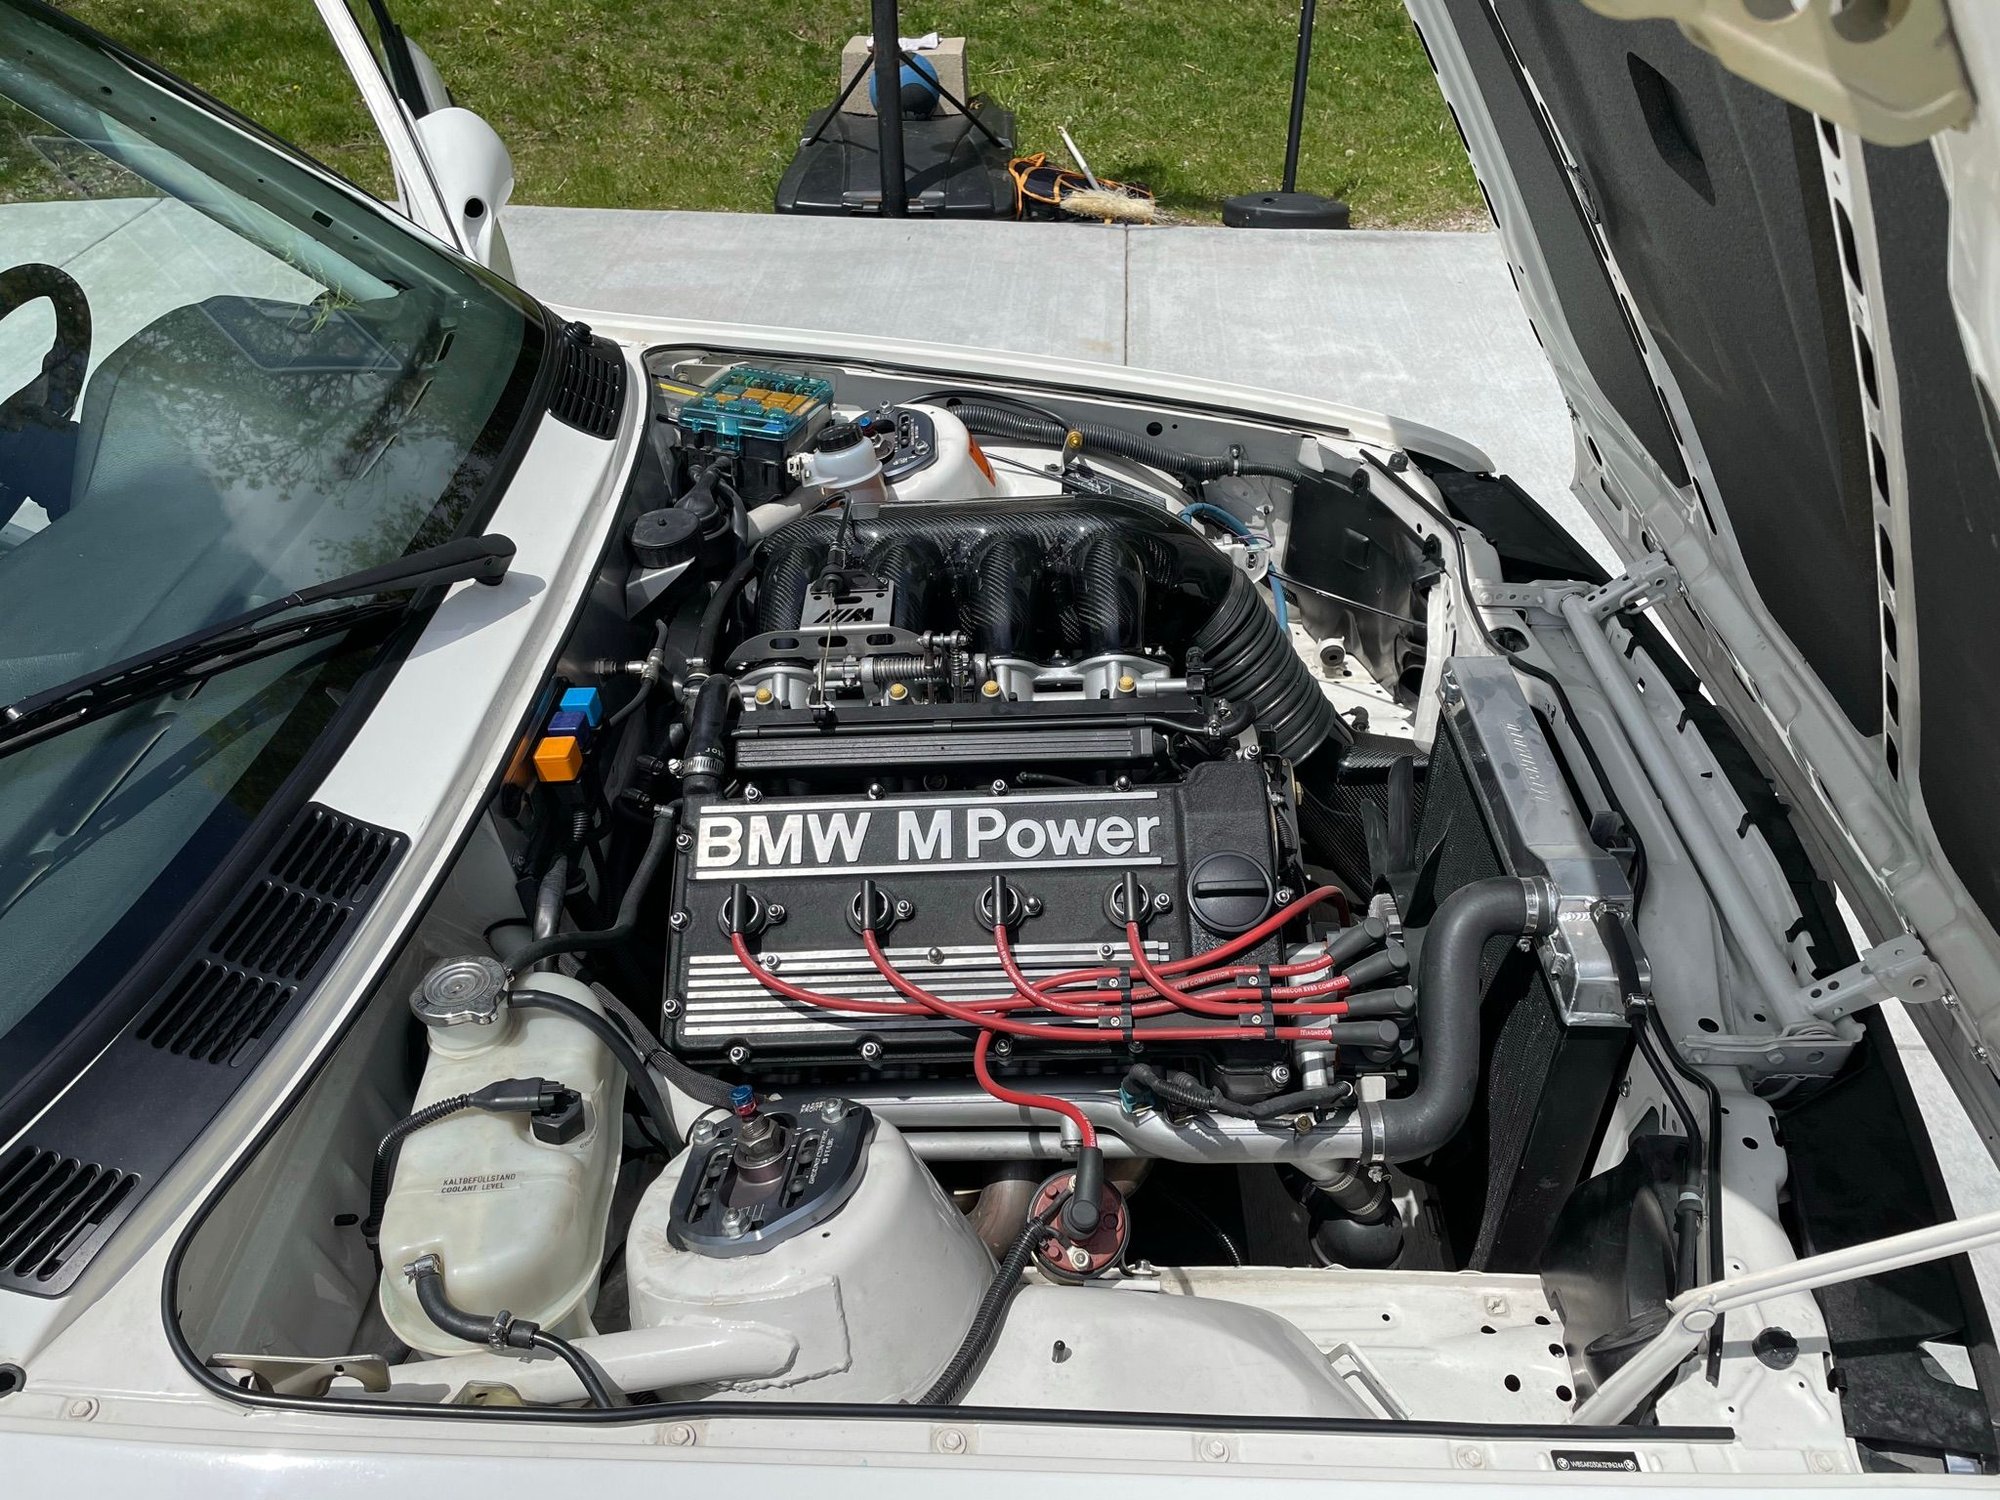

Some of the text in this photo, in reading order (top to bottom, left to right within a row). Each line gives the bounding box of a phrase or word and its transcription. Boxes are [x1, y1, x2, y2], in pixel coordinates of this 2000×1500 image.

[697, 812, 871, 867] BMW
[1190, 971, 1230, 987] COMPETITION
[441, 1182, 505, 1193] COOLANT LEVEL
